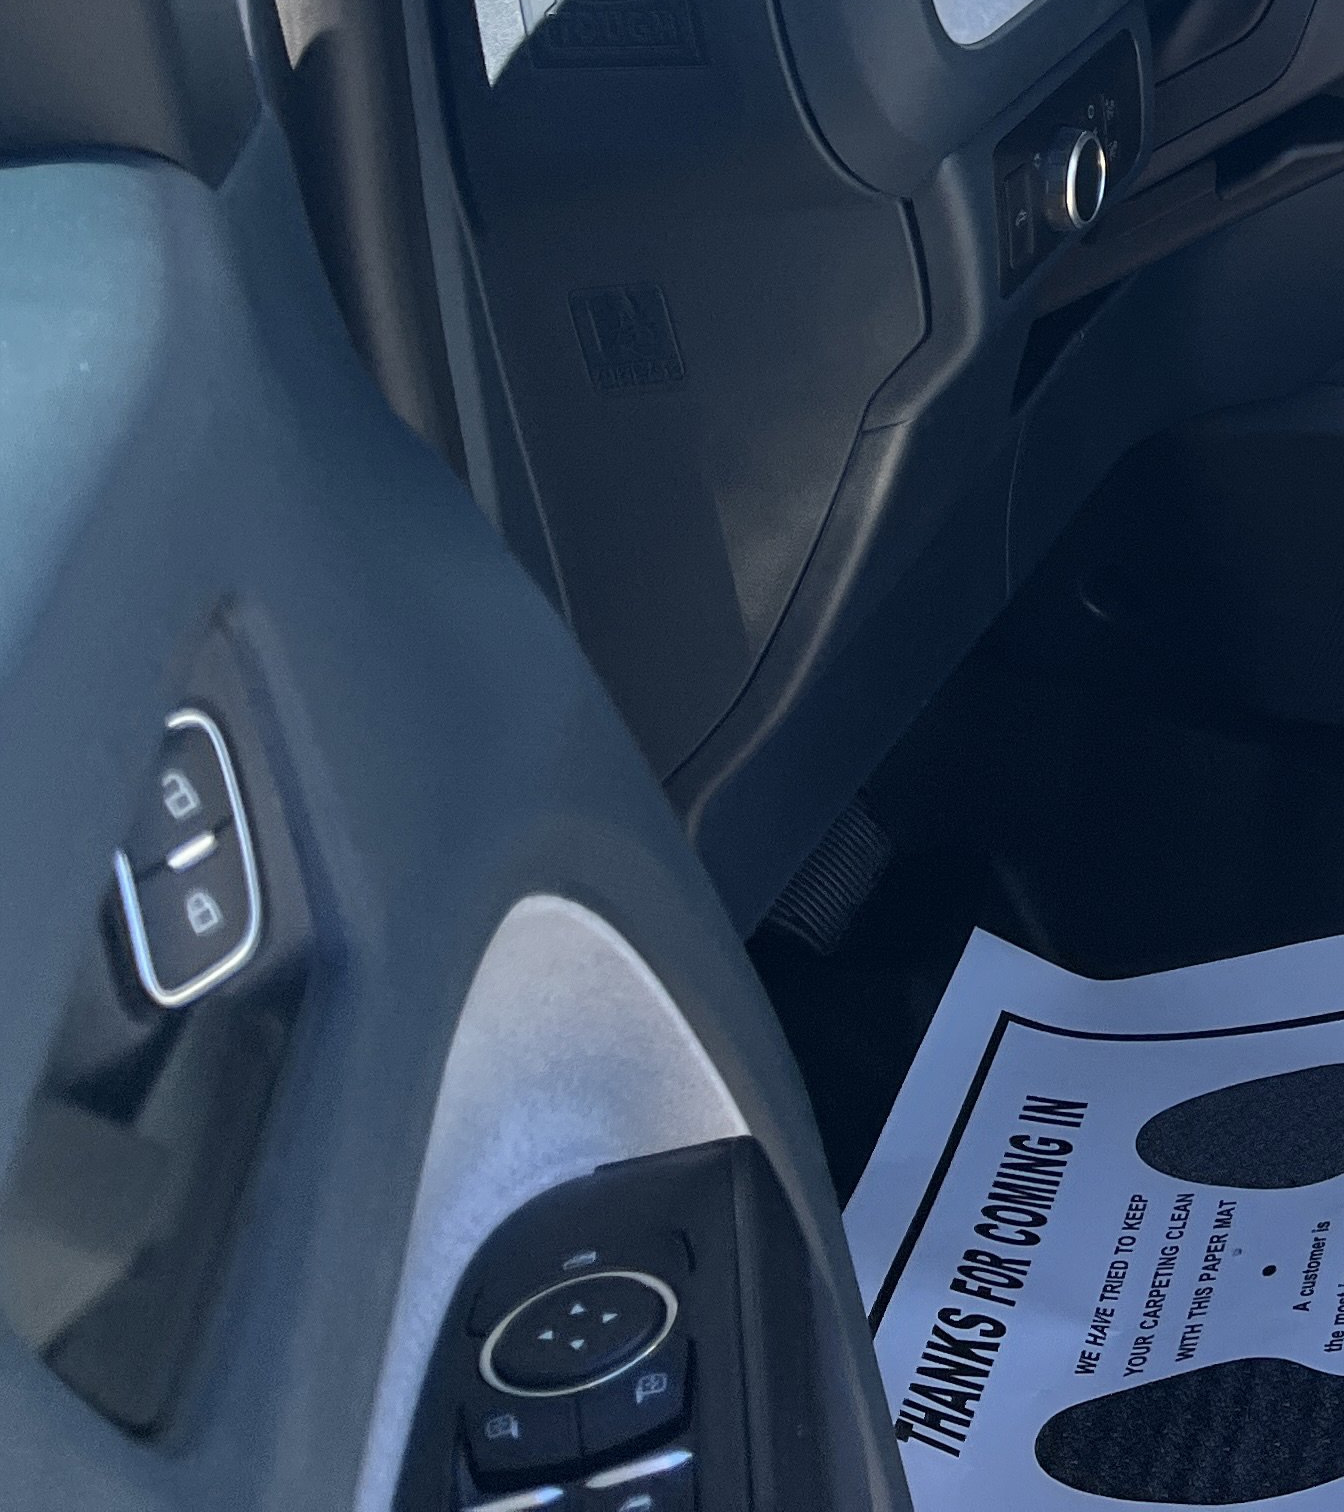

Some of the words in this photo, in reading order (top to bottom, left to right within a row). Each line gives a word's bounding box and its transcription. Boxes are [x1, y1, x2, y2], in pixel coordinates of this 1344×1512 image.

[1018, 1093, 1089, 1128] IN
[973, 1134, 1074, 1247] COMING
[1121, 1193, 1149, 1231] KEEP
[1212, 1198, 1237, 1230] MAT
[1310, 1219, 1332, 1234] is
[1113, 1234, 1137, 1256] TO
[1197, 1232, 1229, 1283] PAPER
[949, 1247, 1033, 1308] FOR
[1098, 1260, 1129, 1303] TRIED
[1123, 1332, 1155, 1378] YOUR
[1139, 1244, 1180, 1330] CARPETING
[1165, 1192, 1195, 1240] CLEAN
[1299, 1235, 1327, 1297] customer
[1186, 1285, 1214, 1320] THIS
[1292, 1299, 1313, 1313] A
[1084, 1305, 1117, 1347] HAVE
[1174, 1322, 1204, 1363] WITH
[1073, 1348, 1102, 1375] WE
[893, 1307, 1008, 1459] THANKS
